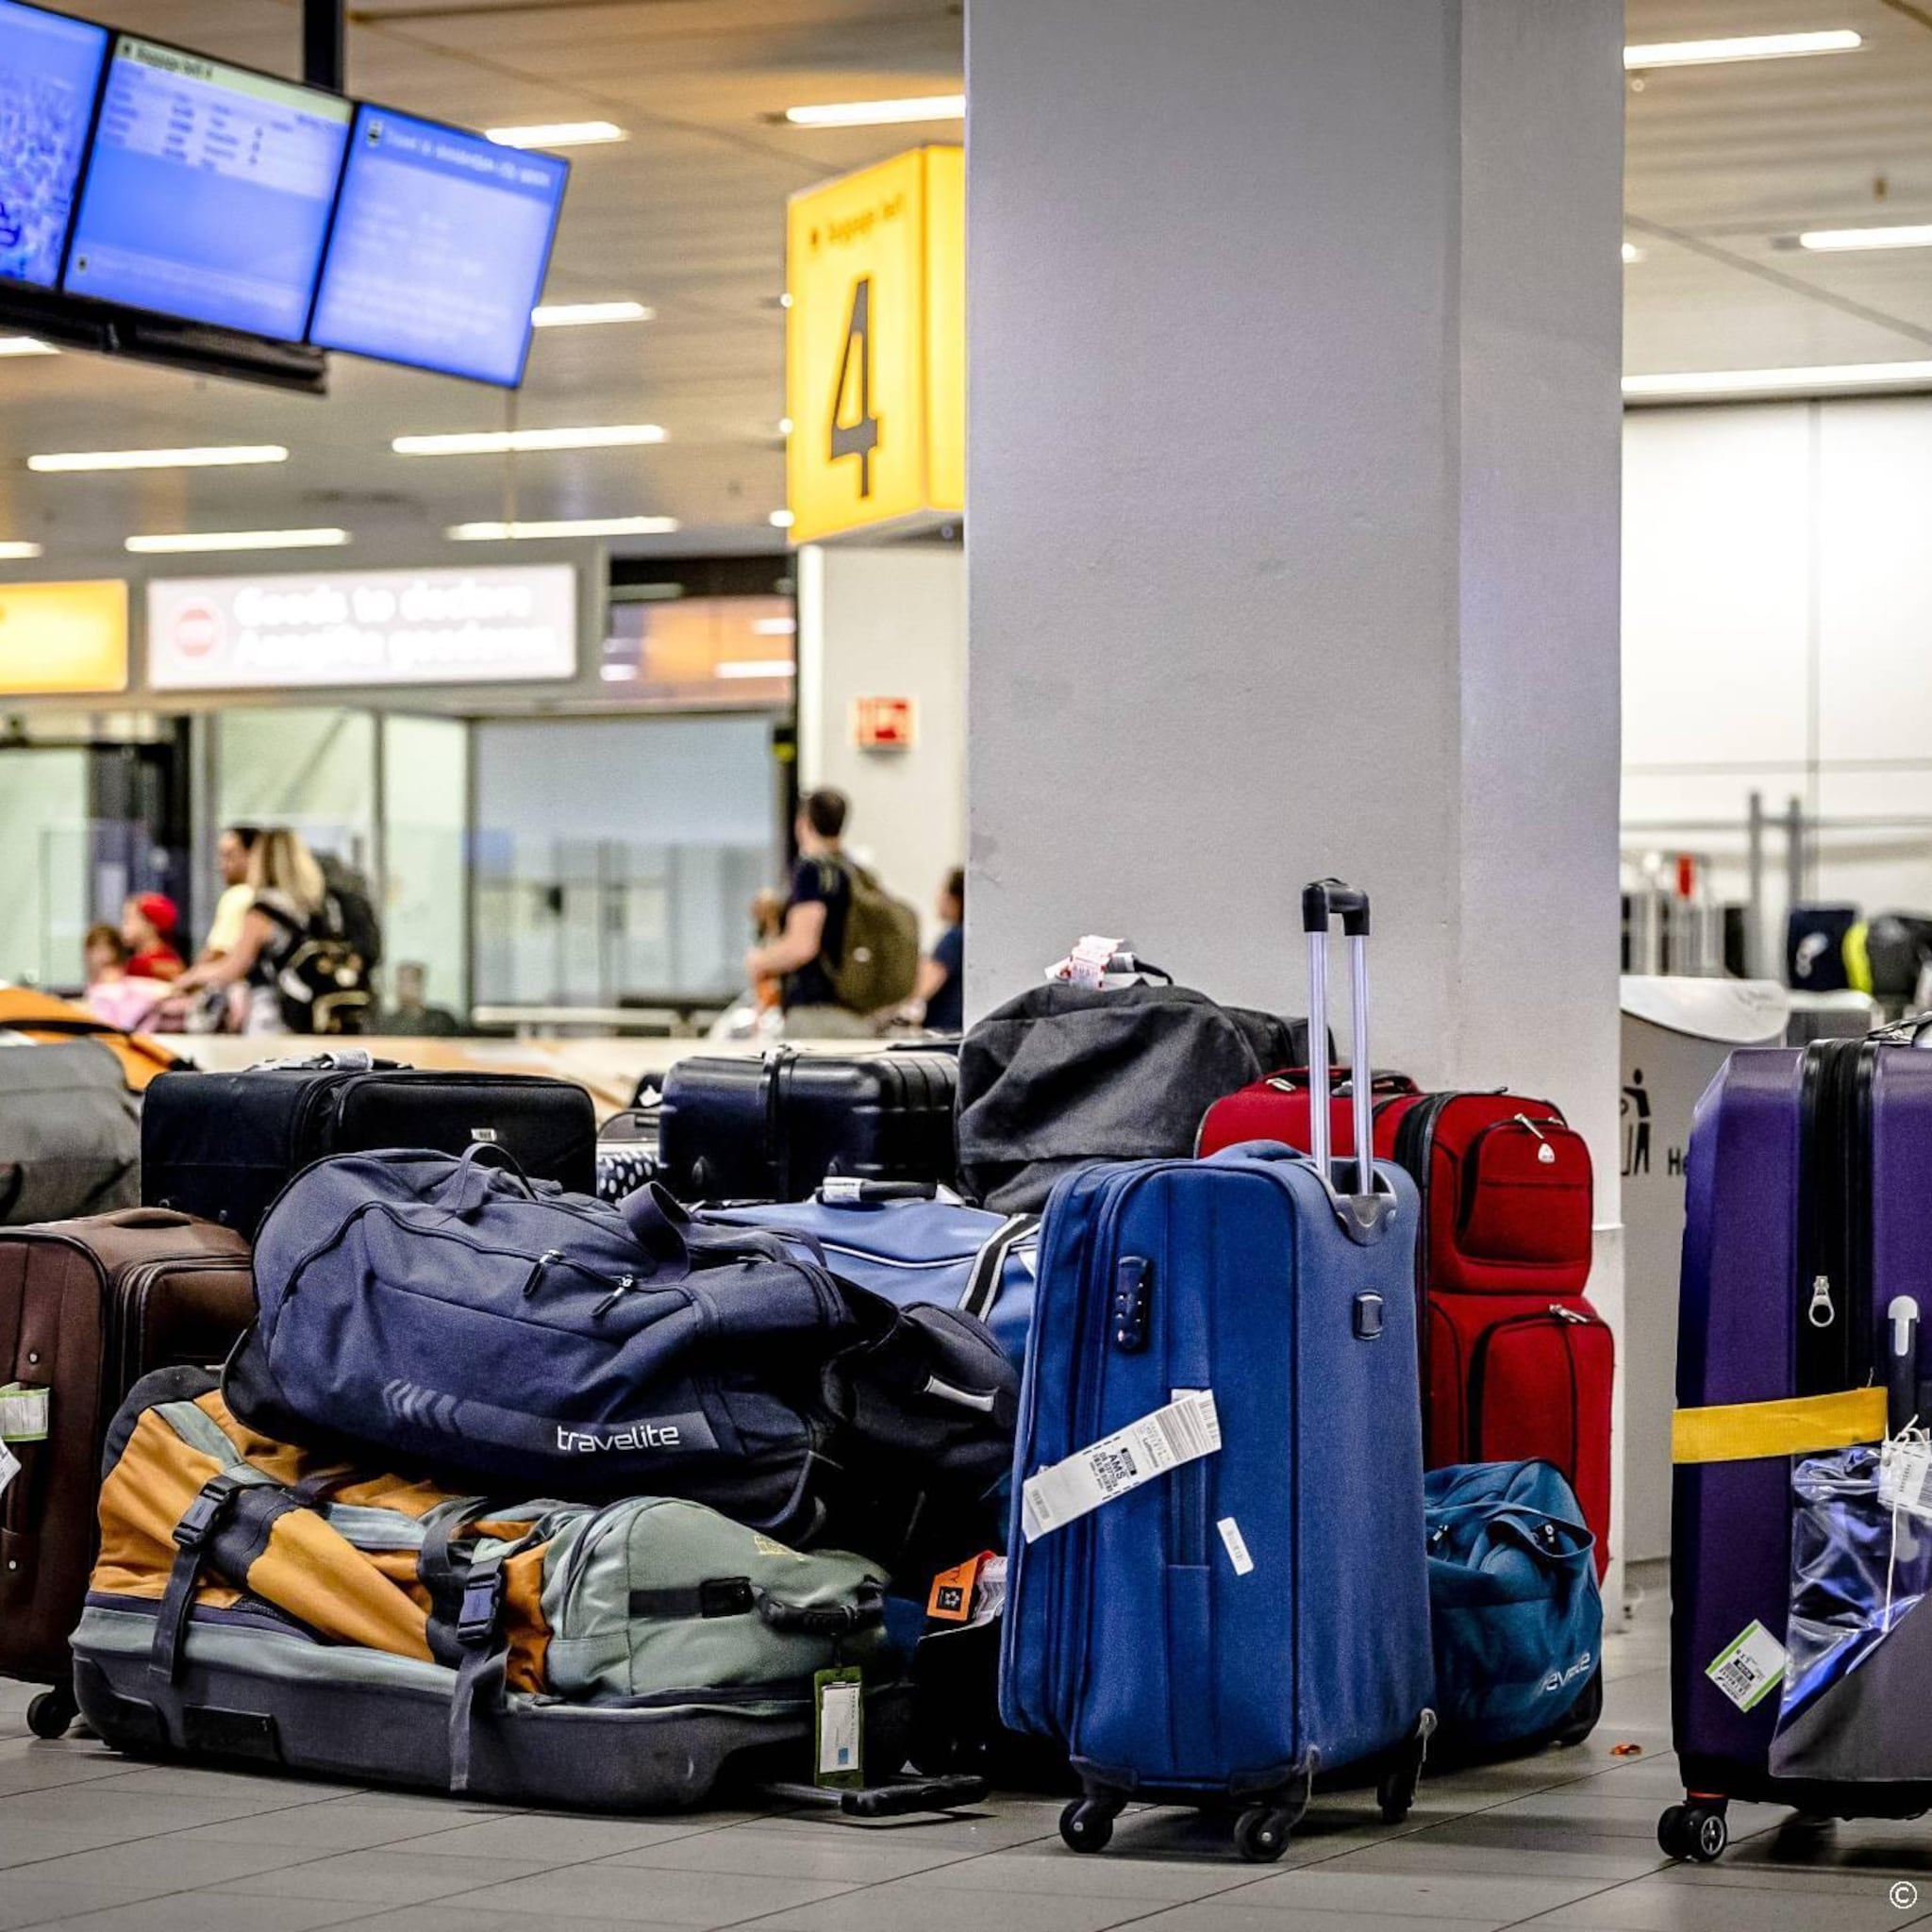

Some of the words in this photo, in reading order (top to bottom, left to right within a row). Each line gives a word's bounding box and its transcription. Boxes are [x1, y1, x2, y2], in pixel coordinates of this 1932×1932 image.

[829, 277, 878, 498] 4
[557, 1424, 680, 1453] travelite
[1108, 1454, 1125, 1479] AMS
